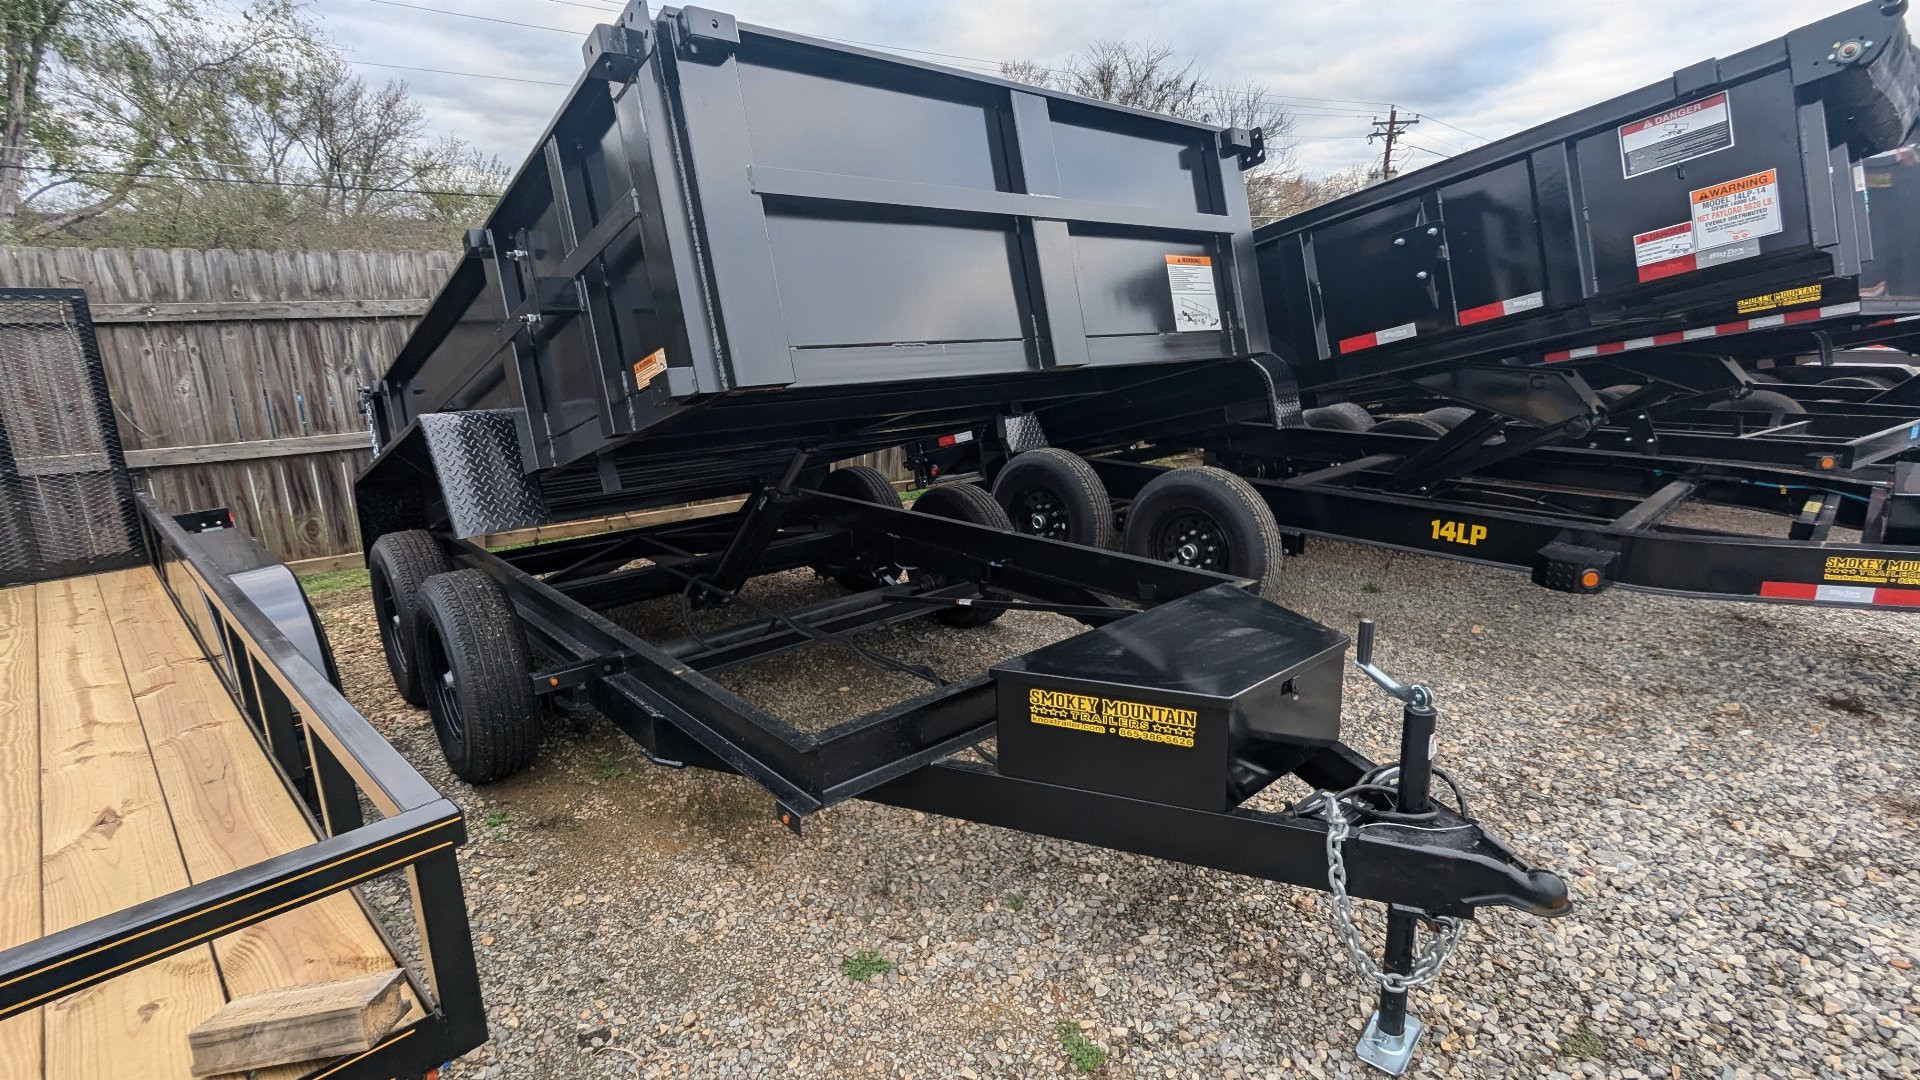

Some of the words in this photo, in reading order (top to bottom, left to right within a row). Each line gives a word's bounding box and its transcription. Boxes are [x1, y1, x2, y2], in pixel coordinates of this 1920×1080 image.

[1654, 103, 1702, 125] DANGER
[1710, 175, 1768, 197] WARNING
[1702, 197, 1731, 209] MODEL
[1733, 187, 1766, 201] 14LP-14
[1696, 213, 1710, 223] NET
[1711, 206, 1742, 219] PAYLOAD
[1705, 216, 1726, 228] EVENLY
[1727, 207, 1768, 221] DISTRIBUTED
[1773, 284, 1821, 300] MOUNTAIN
[1431, 519, 1487, 545] 14LP
[1826, 556, 1886, 570] SMOKEY
[1029, 688, 1099, 714] SMOKEY
[1102, 699, 1197, 728] MOUNTAIN
[1031, 714, 1105, 734] knoxtrailer.com
[1119, 728, 1194, 748] 865-986-5626
[1070, 710, 1149, 731] TRAILERS
